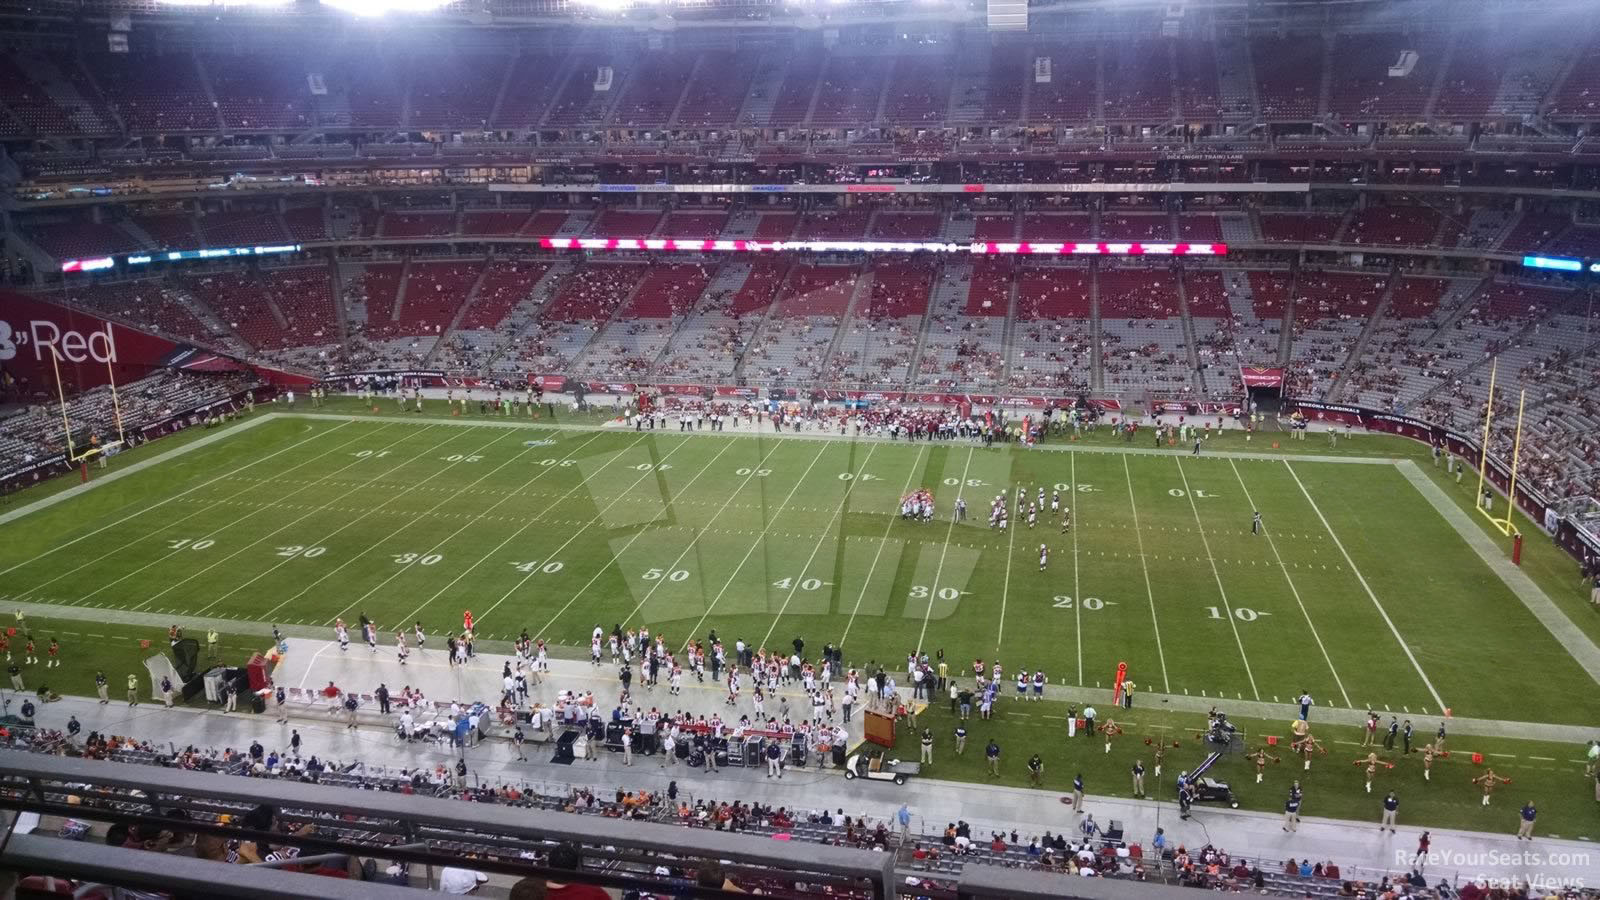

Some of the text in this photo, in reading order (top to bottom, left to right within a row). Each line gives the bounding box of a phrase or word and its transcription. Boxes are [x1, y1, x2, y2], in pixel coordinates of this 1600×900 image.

[1298, 401, 1360, 414] ARIZONA CARDINALS
[445, 454, 485, 463] 20
[539, 458, 577, 468] 30
[635, 463, 673, 472] 40
[735, 467, 773, 477] 50
[838, 473, 878, 482] 40
[943, 477, 983, 487] 30
[1053, 483, 1095, 493] 20
[1168, 488, 1210, 498] 10
[168, 538, 216, 551] 10
[275, 545, 327, 558] 20
[393, 553, 444, 566] 30
[514, 561, 564, 574] 40
[641, 568, 690, 582] 50
[772, 577, 823, 591] 40
[908, 585, 960, 601] 30
[1052, 595, 1105, 611] 20
[1205, 605, 1259, 622] 10
